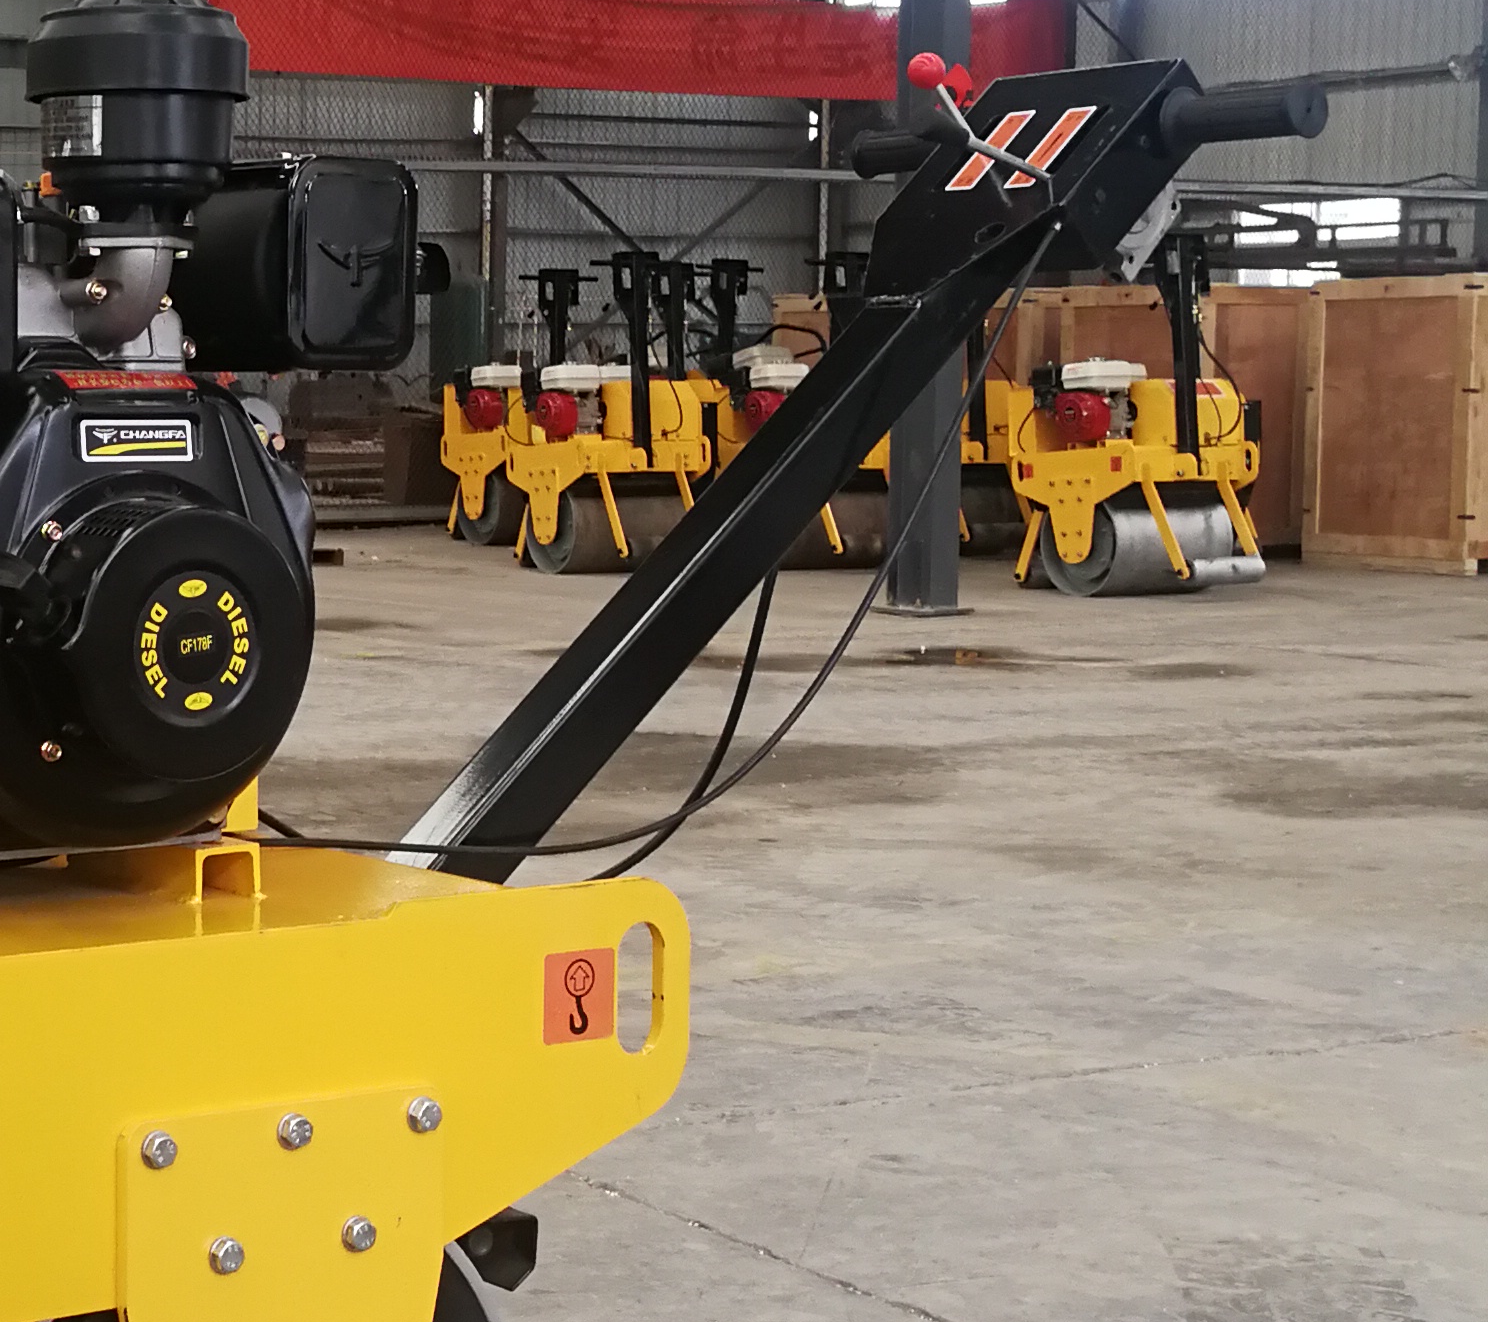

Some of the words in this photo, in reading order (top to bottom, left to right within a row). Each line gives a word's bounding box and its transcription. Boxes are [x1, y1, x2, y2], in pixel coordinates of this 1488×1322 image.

[120, 429, 187, 440] CHANGFA
[140, 602, 168, 699] DIESEL
[180, 634, 213, 655] CF178F
[217, 590, 250, 685] DIESEL
